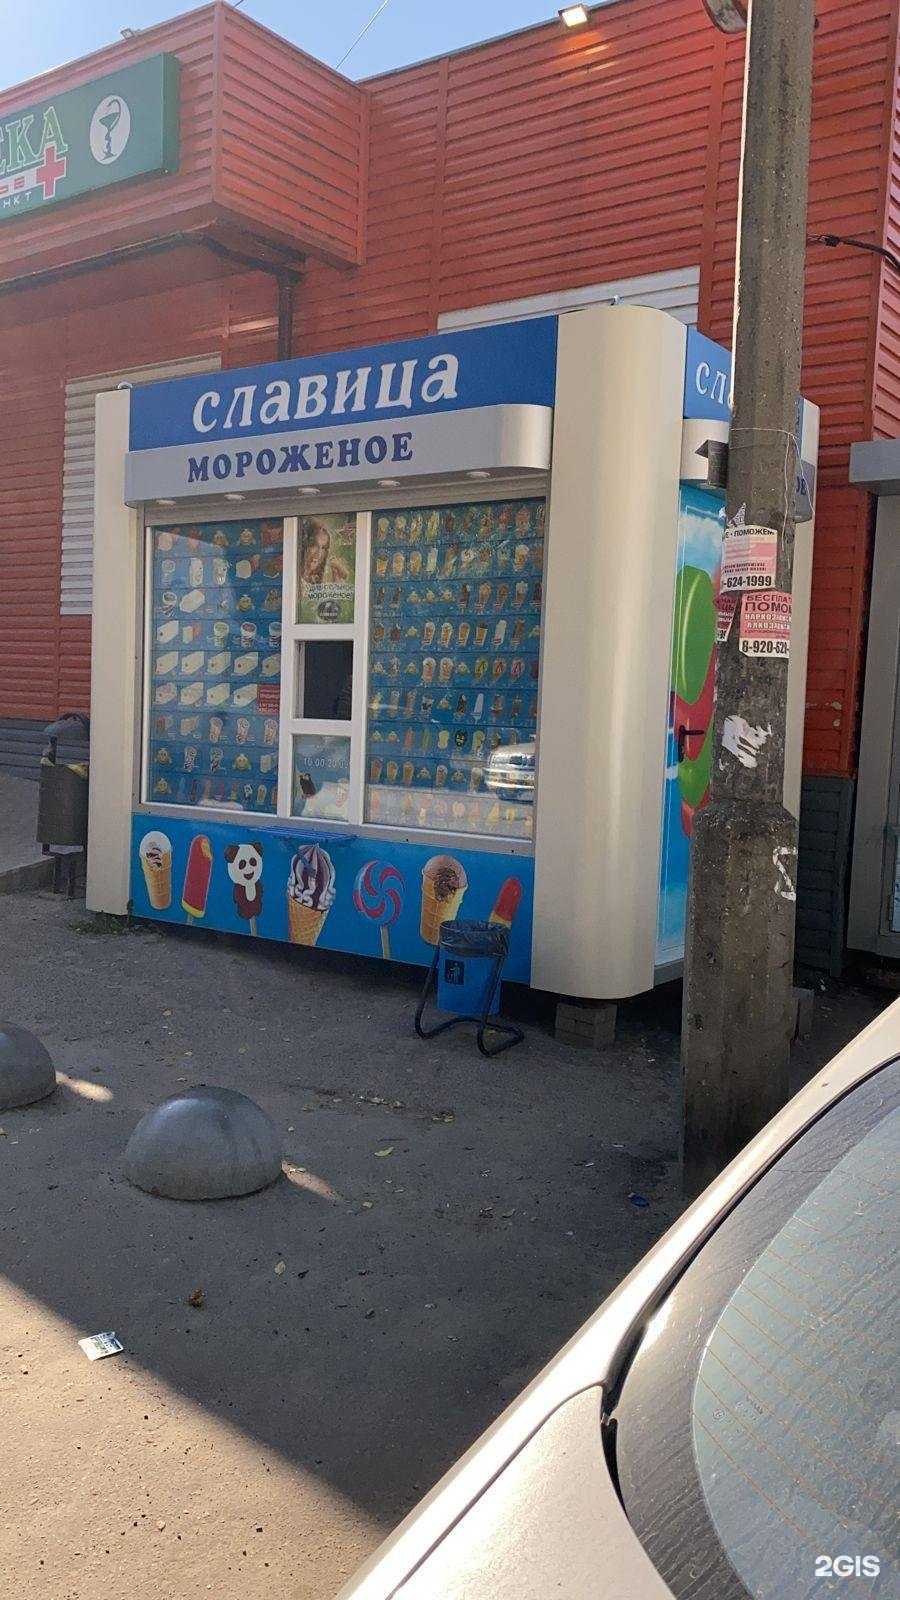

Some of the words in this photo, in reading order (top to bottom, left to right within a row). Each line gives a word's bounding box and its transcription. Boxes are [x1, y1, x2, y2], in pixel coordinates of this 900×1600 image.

[0, 106, 68, 175] КА
[191, 353, 461, 434] славица
[187, 431, 414, 483] МОРОЖЕНОЕ
[723, 575, 772, 588] -624-1999
